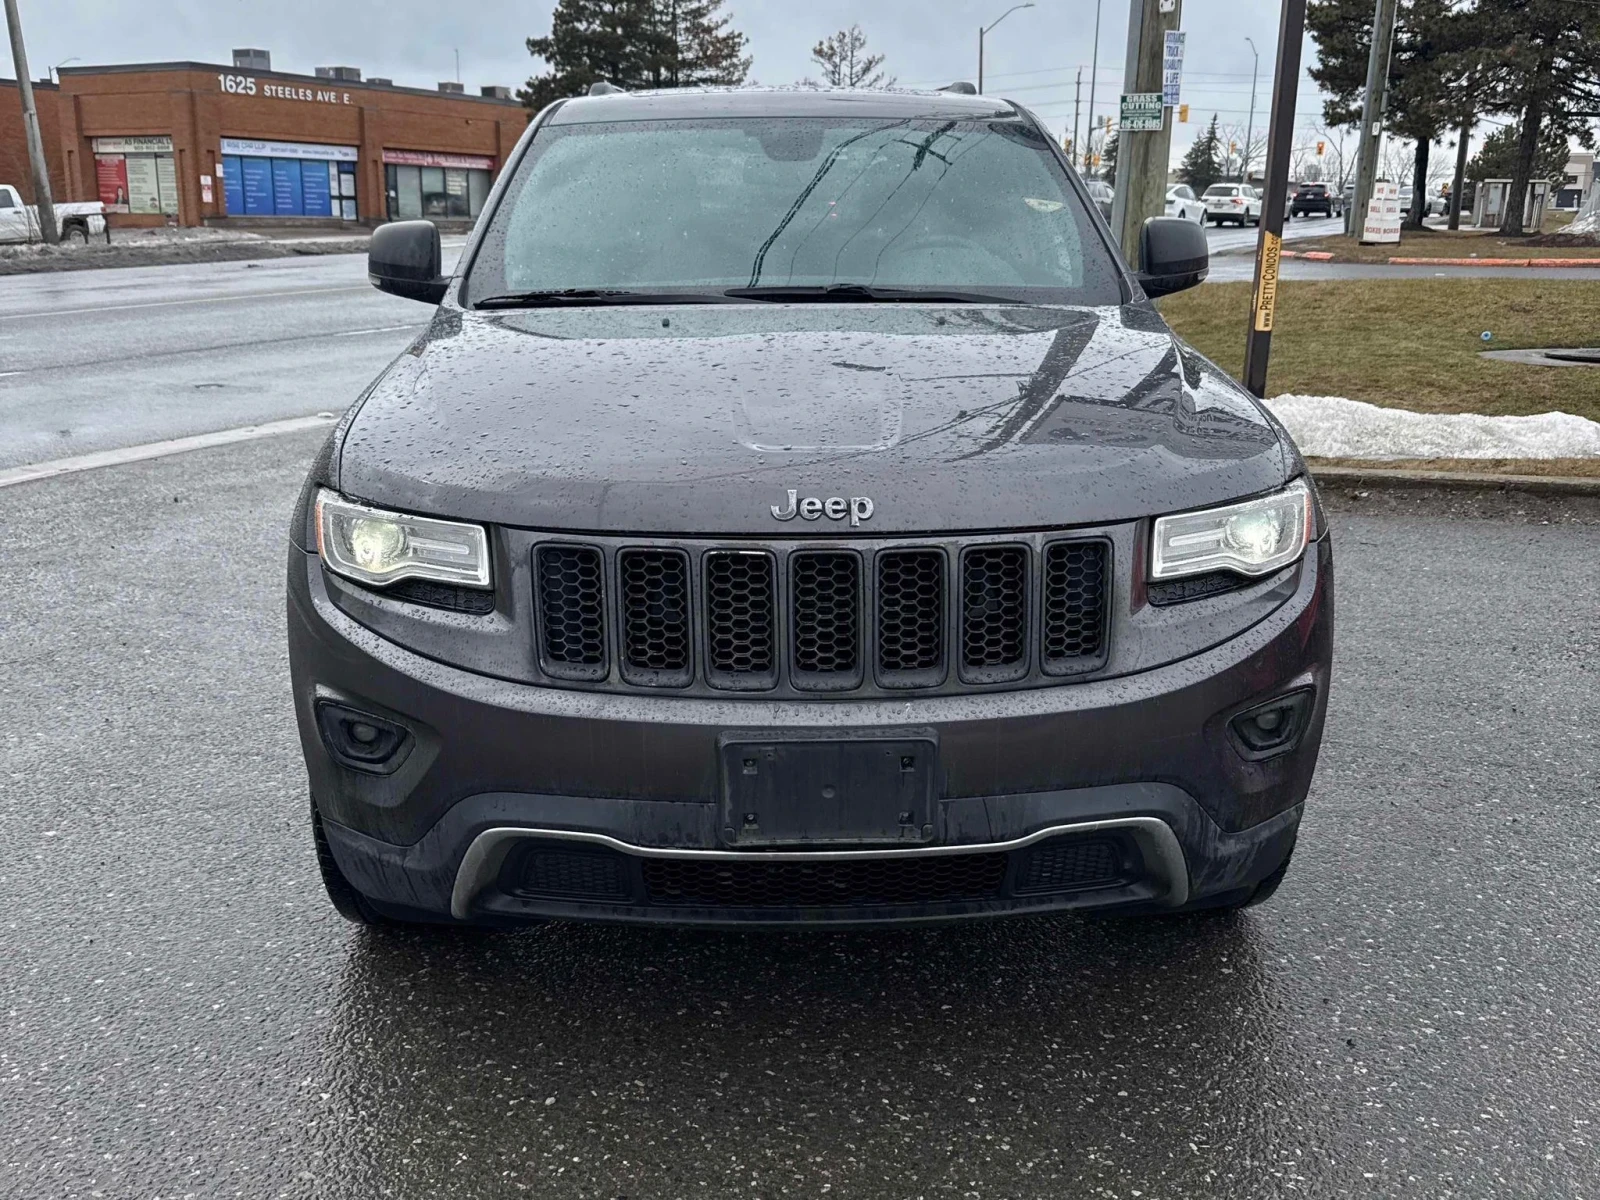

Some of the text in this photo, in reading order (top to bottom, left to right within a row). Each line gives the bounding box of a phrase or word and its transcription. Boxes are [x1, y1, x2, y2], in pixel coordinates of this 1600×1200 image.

[1166, 45, 1179, 57] TRUCK
[1170, 72, 1179, 83] LIFE
[218, 73, 354, 104] 1625 STEELES AVE. E.
[1126, 95, 1157, 103] GRASS
[1122, 102, 1161, 110] CUTTING
[1365, 226, 1381, 234] BOXES
[770, 489, 875, 527] Jeep
